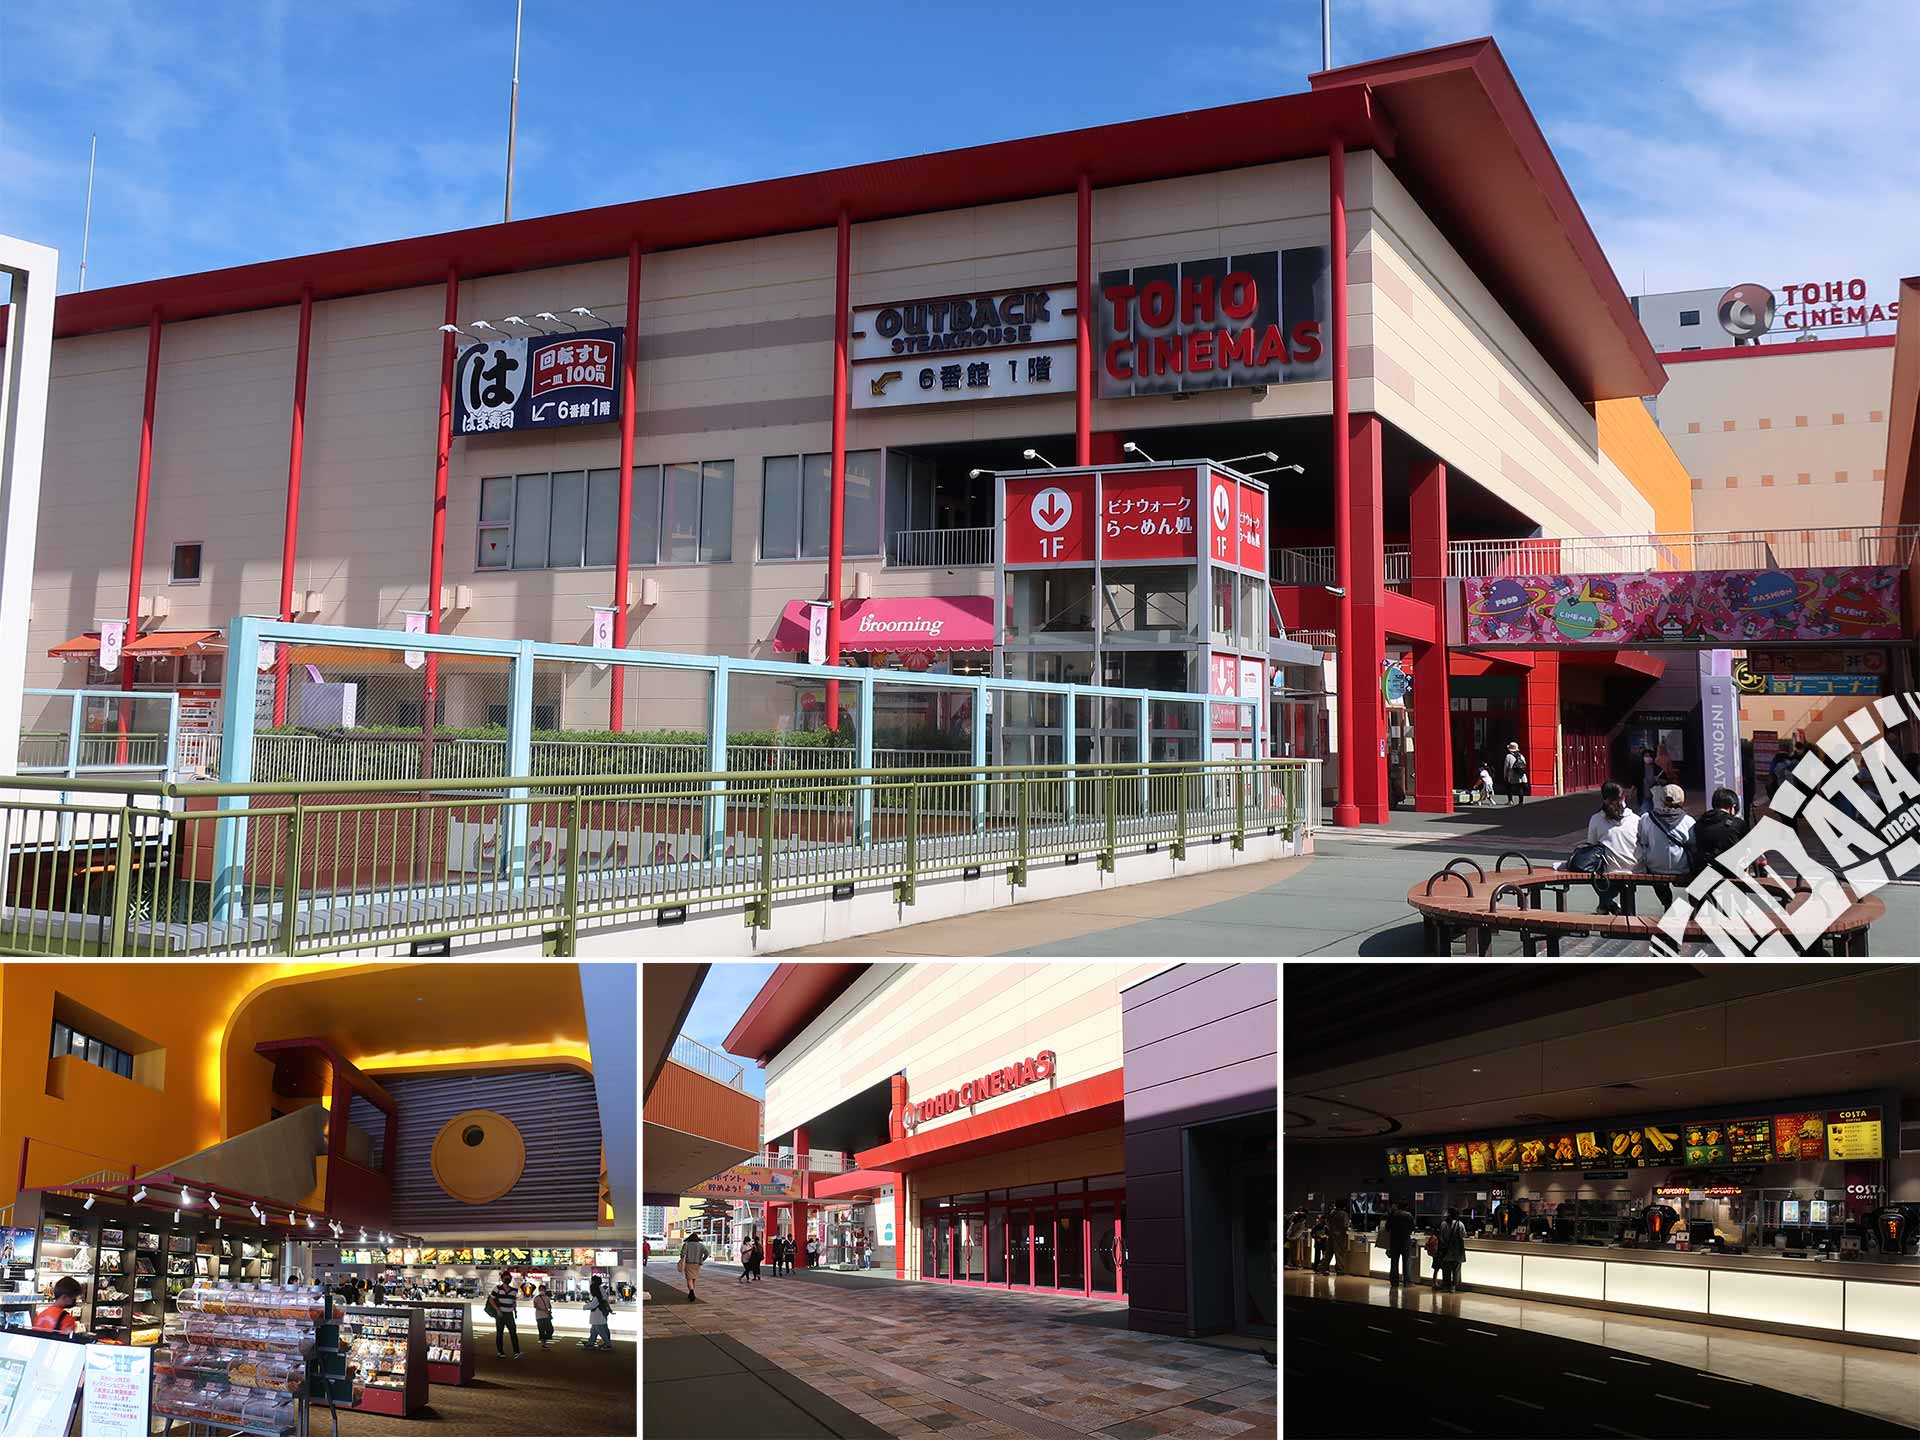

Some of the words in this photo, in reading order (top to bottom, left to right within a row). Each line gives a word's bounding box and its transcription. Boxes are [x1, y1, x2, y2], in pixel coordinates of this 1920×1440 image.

[1105, 271, 1258, 332] TOHO
[1783, 278, 1866, 306] TOHO
[874, 290, 1051, 339] OUTBACK
[1784, 302, 1899, 329] CINEMAS
[891, 323, 1032, 354] STEAKHOUSE
[540, 344, 608, 371] 回転すし
[1105, 321, 1323, 380] CINEMAS
[918, 363, 991, 391] 6番館
[557, 398, 611, 420] 6番館1階
[462, 410, 515, 433] はま寿司
[1107, 496, 1192, 515] ビナウォーク
[1039, 536, 1065, 558] 1F
[1216, 535, 1227, 558] 1F
[1495, 596, 1519, 608] FOOD
[1752, 587, 1793, 603] FASHION
[1559, 611, 1594, 624] CINEMA
[1834, 606, 1868, 618] EVENT
[599, 623, 607, 640] 6
[815, 619, 821, 637] 6
[107, 632, 116, 647] 6
[917, 1088, 957, 1122] TOHO
[960, 1050, 1057, 1106] CINEMAS
[1840, 1110, 1867, 1119] COSTA
[1847, 1184, 1886, 1195] COSTA
